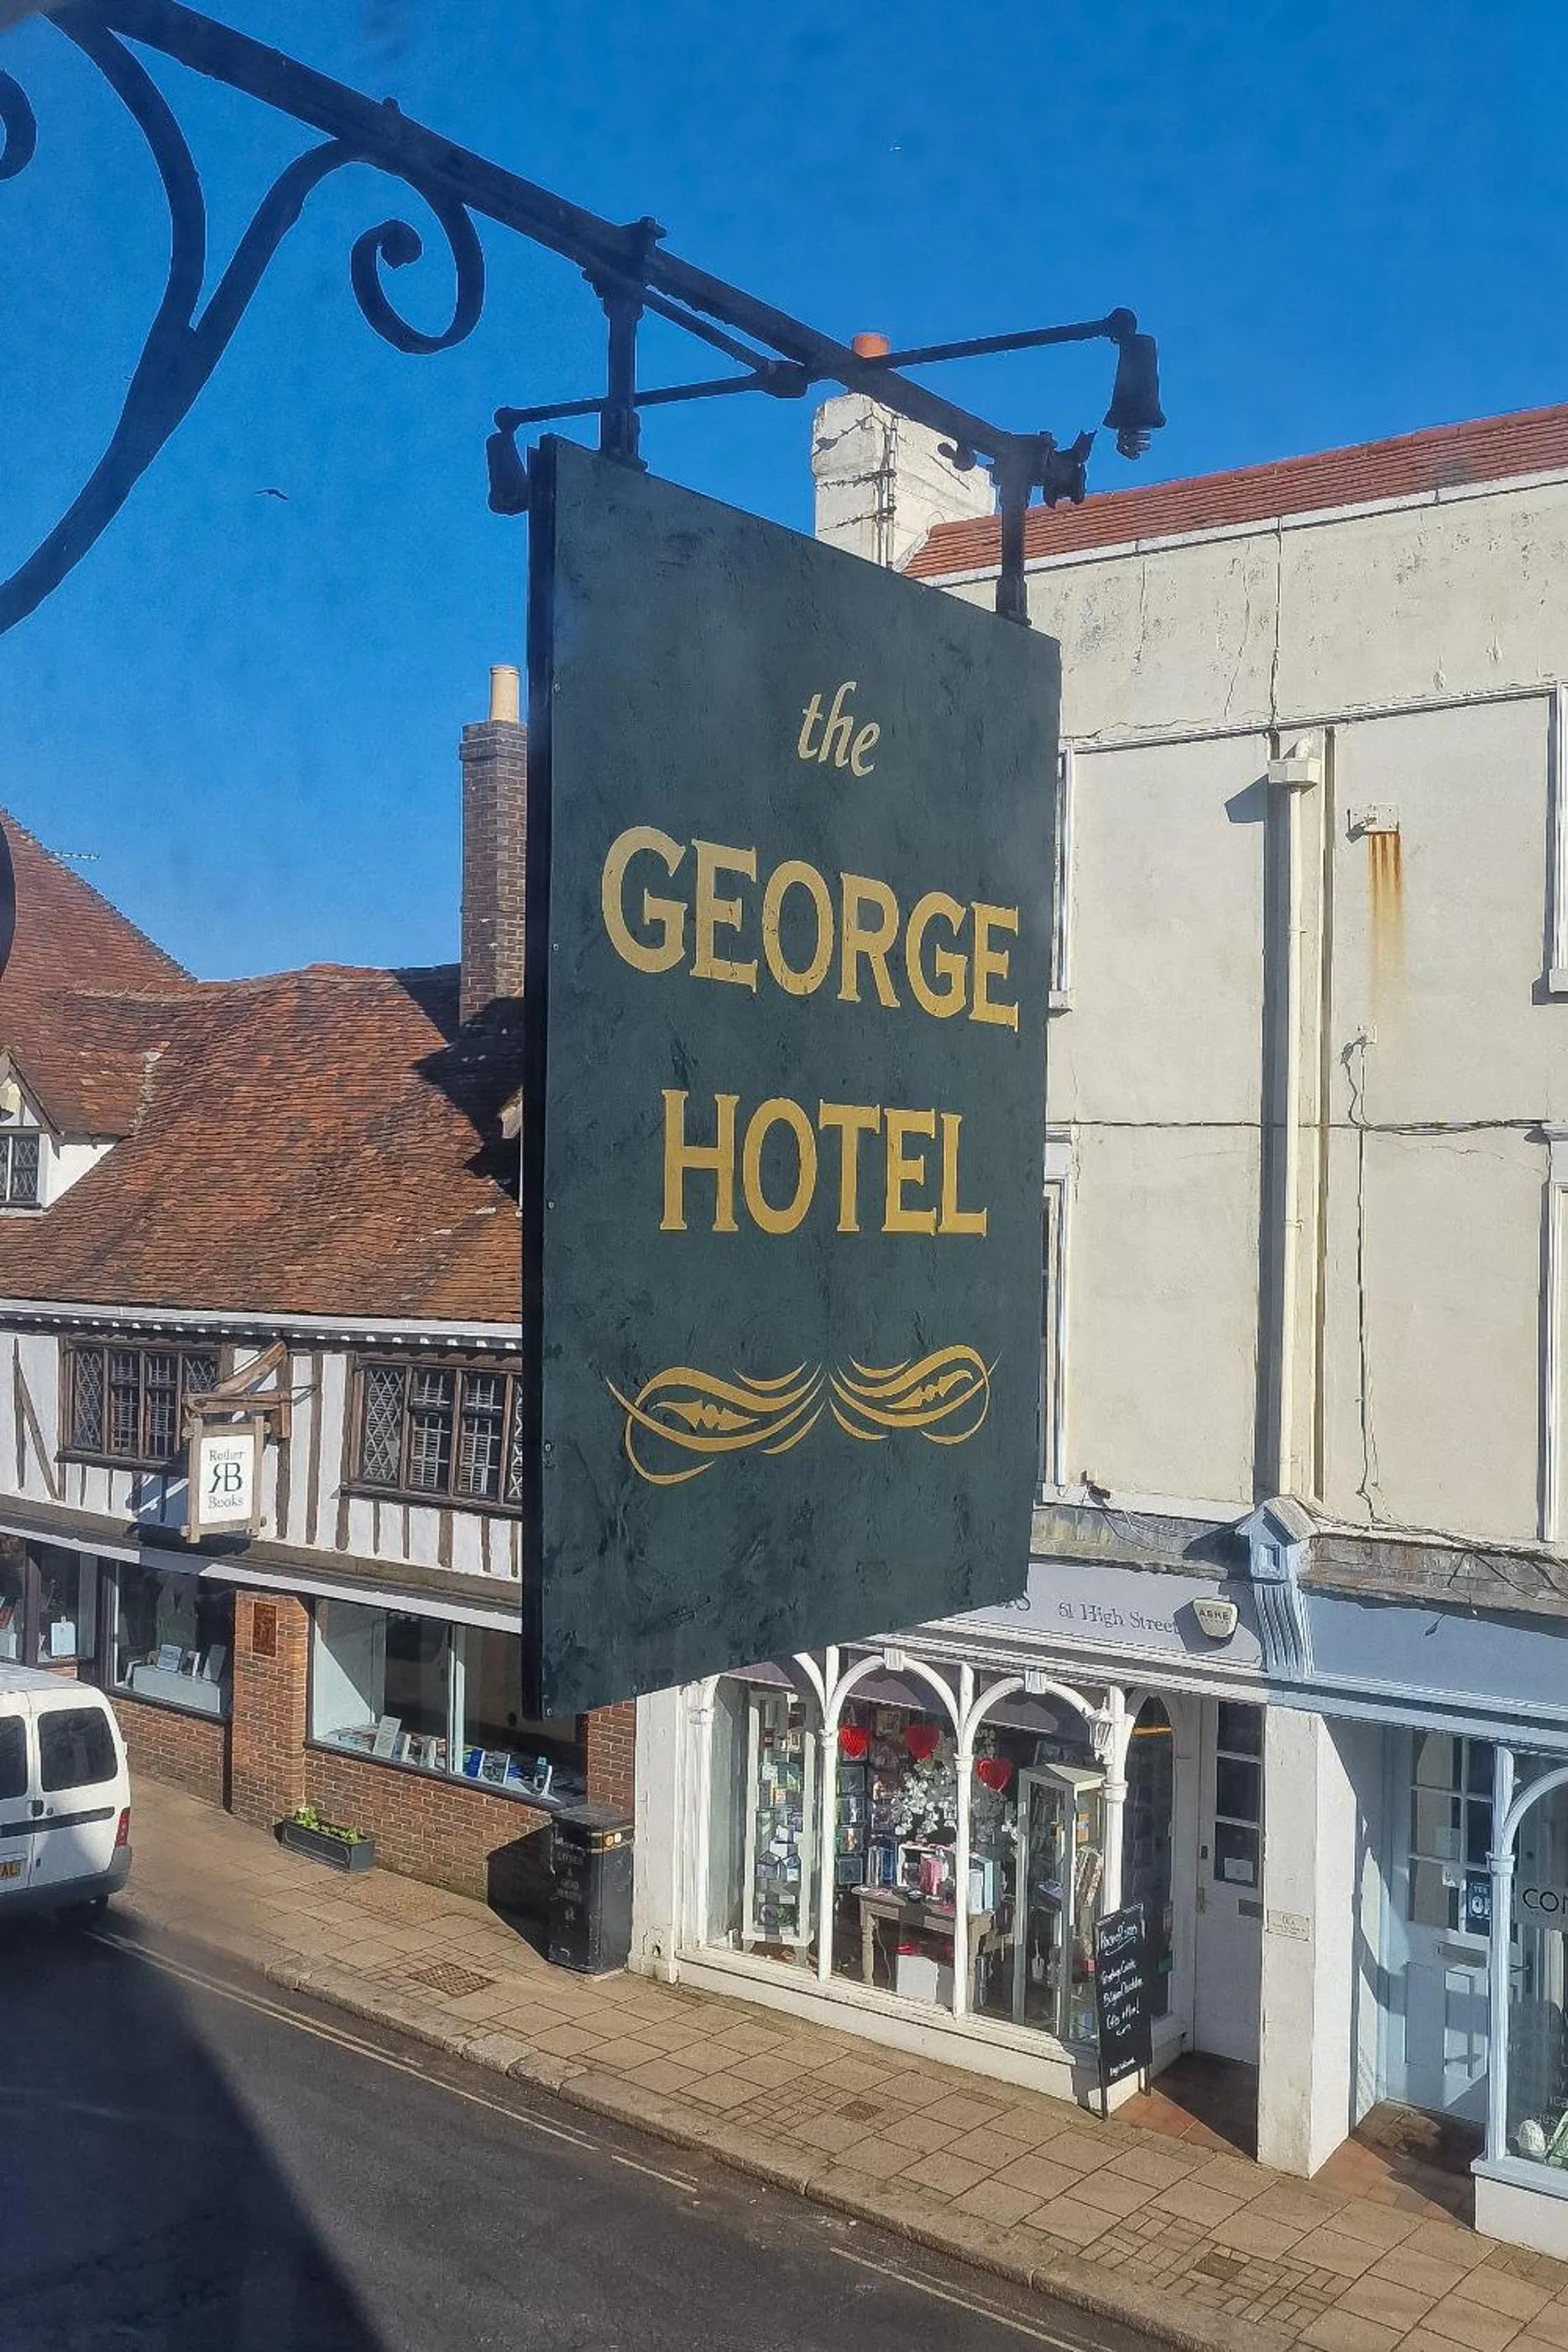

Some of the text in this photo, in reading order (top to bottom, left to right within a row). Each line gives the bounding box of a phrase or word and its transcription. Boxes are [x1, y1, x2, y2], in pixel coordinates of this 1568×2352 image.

[797, 682, 880, 776] the
[602, 826, 1018, 1032] GEORGE
[660, 1090, 987, 1237] HOTEL
[208, 1494, 244, 1508] Books
[1080, 1603, 1124, 1628] High
[1130, 1611, 1181, 1634] Street
